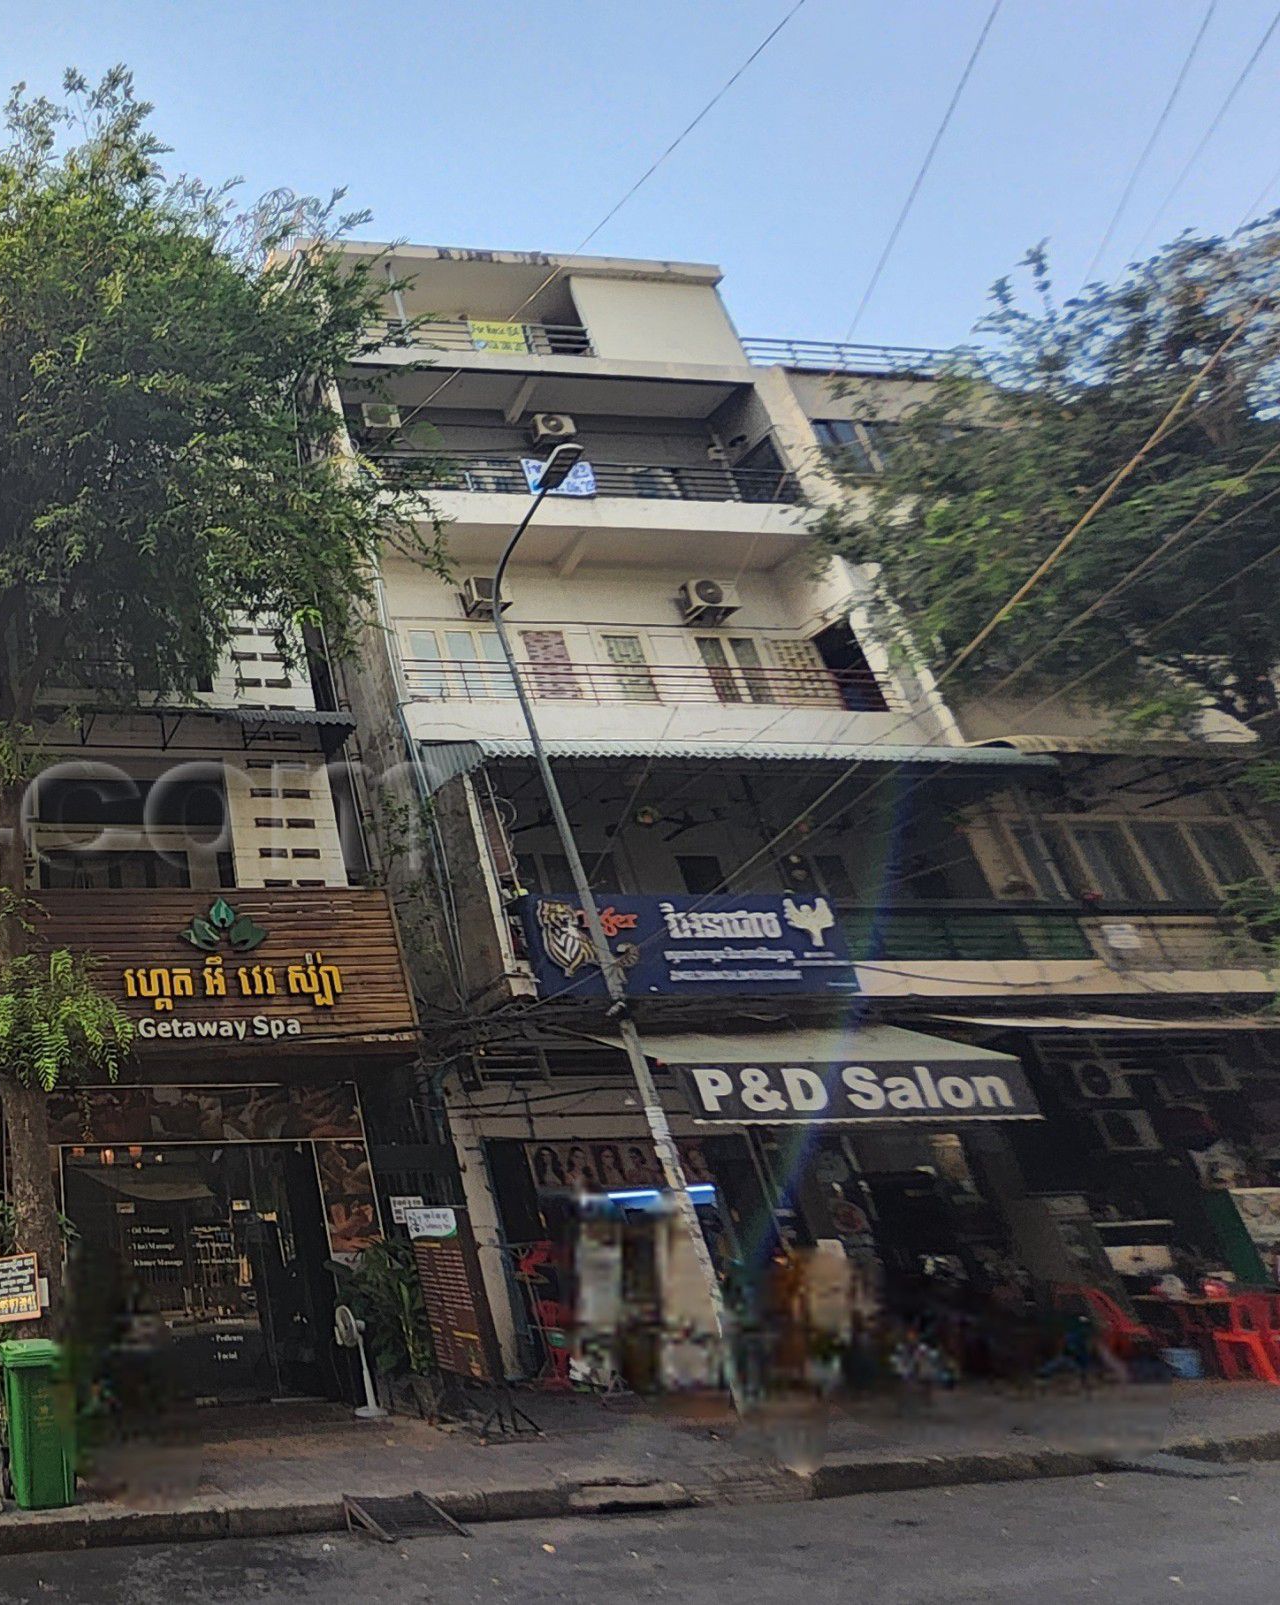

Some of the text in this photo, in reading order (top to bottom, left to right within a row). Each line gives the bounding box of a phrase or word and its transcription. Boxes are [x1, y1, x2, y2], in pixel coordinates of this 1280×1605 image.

[137, 1015, 302, 1041] Getaway Spa
[691, 1066, 1016, 1114] P&D Salon
